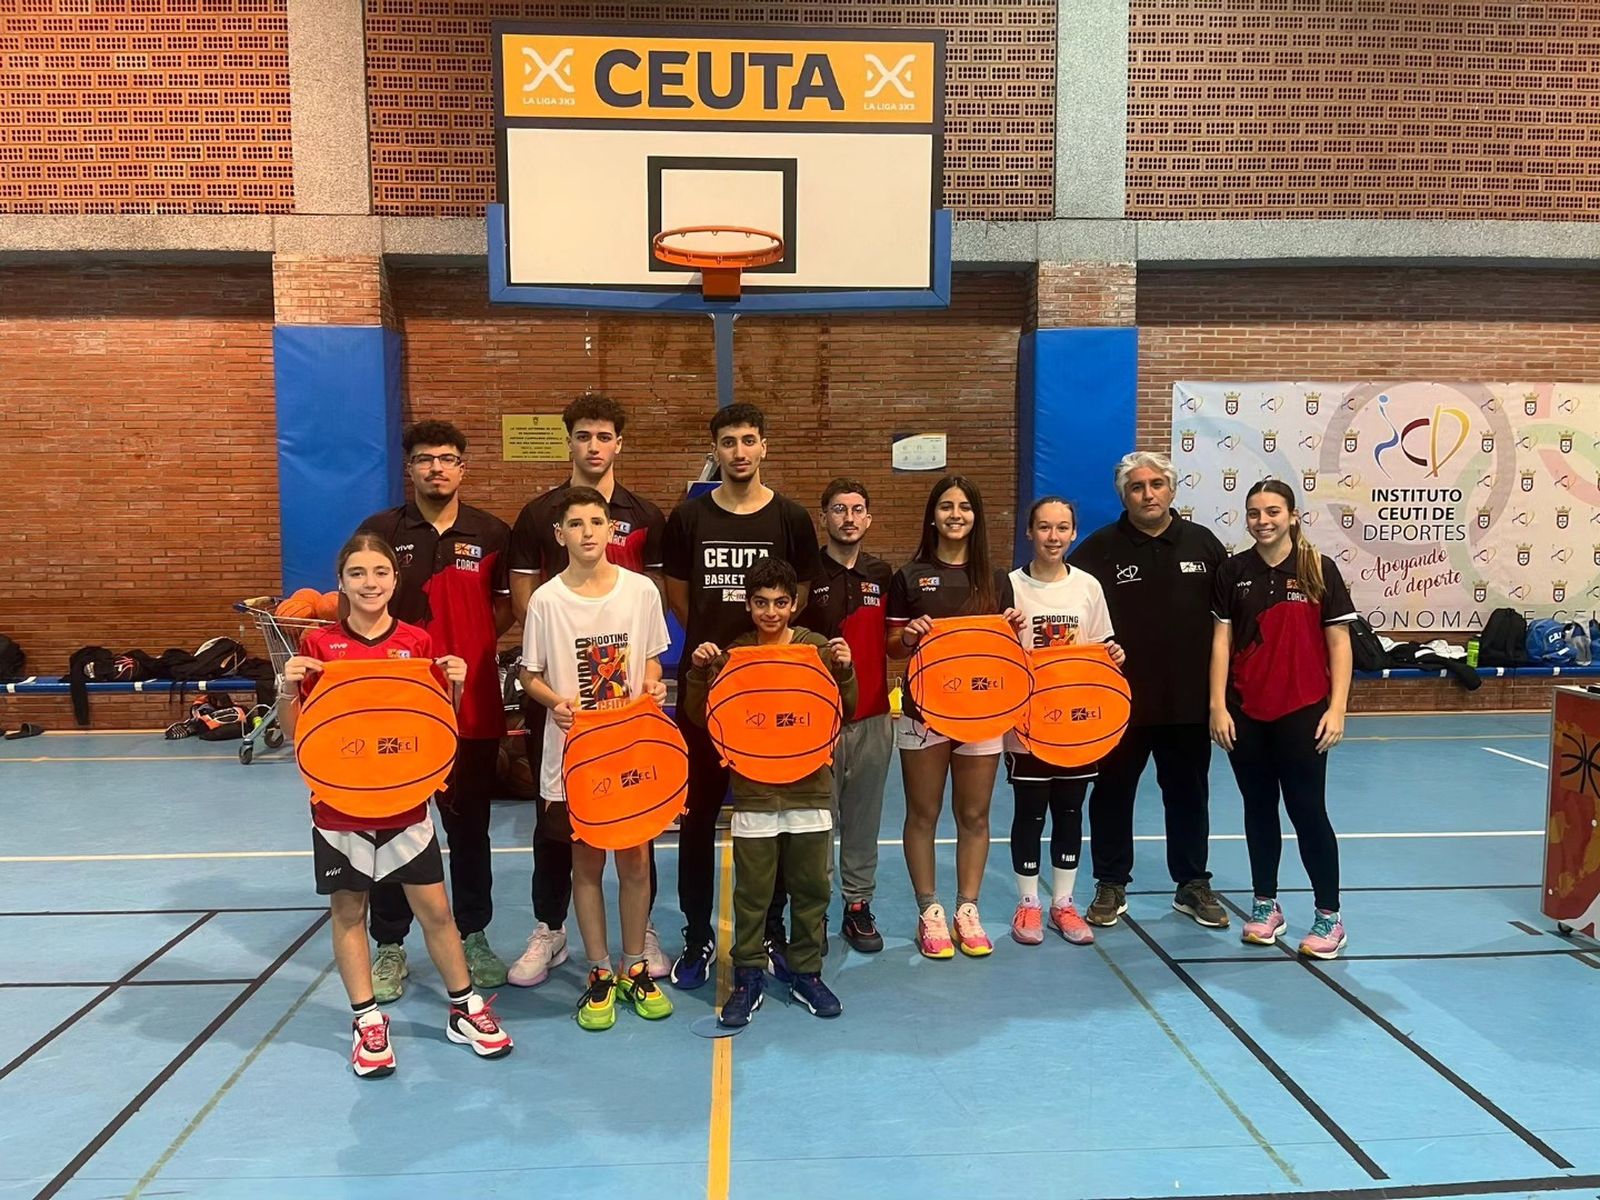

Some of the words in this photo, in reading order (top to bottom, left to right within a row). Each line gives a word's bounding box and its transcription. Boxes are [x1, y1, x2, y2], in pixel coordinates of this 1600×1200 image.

[594, 48, 846, 111] CEUTA
[523, 97, 536, 105] LA
[537, 97, 557, 105] LIGA
[864, 103, 876, 111] LA
[877, 103, 897, 111] LIGA
[1371, 488, 1462, 502] INSTITUTO
[1378, 506, 1428, 521] CEUTI
[1432, 506, 1455, 521] DE
[1363, 523, 1467, 542] DEPORTES
[456, 558, 480, 573] COACH
[1360, 548, 1447, 582] Apoyando
[704, 573, 746, 586] BASKET
[1384, 580, 1401, 598] al
[1405, 569, 1463, 598] deporte
[1042, 614, 1079, 624] SHOOTING
[1366, 606, 1484, 629] ÓNOMA
[587, 632, 629, 648] SHOOTING
[575, 637, 598, 711] NAVIDAD
